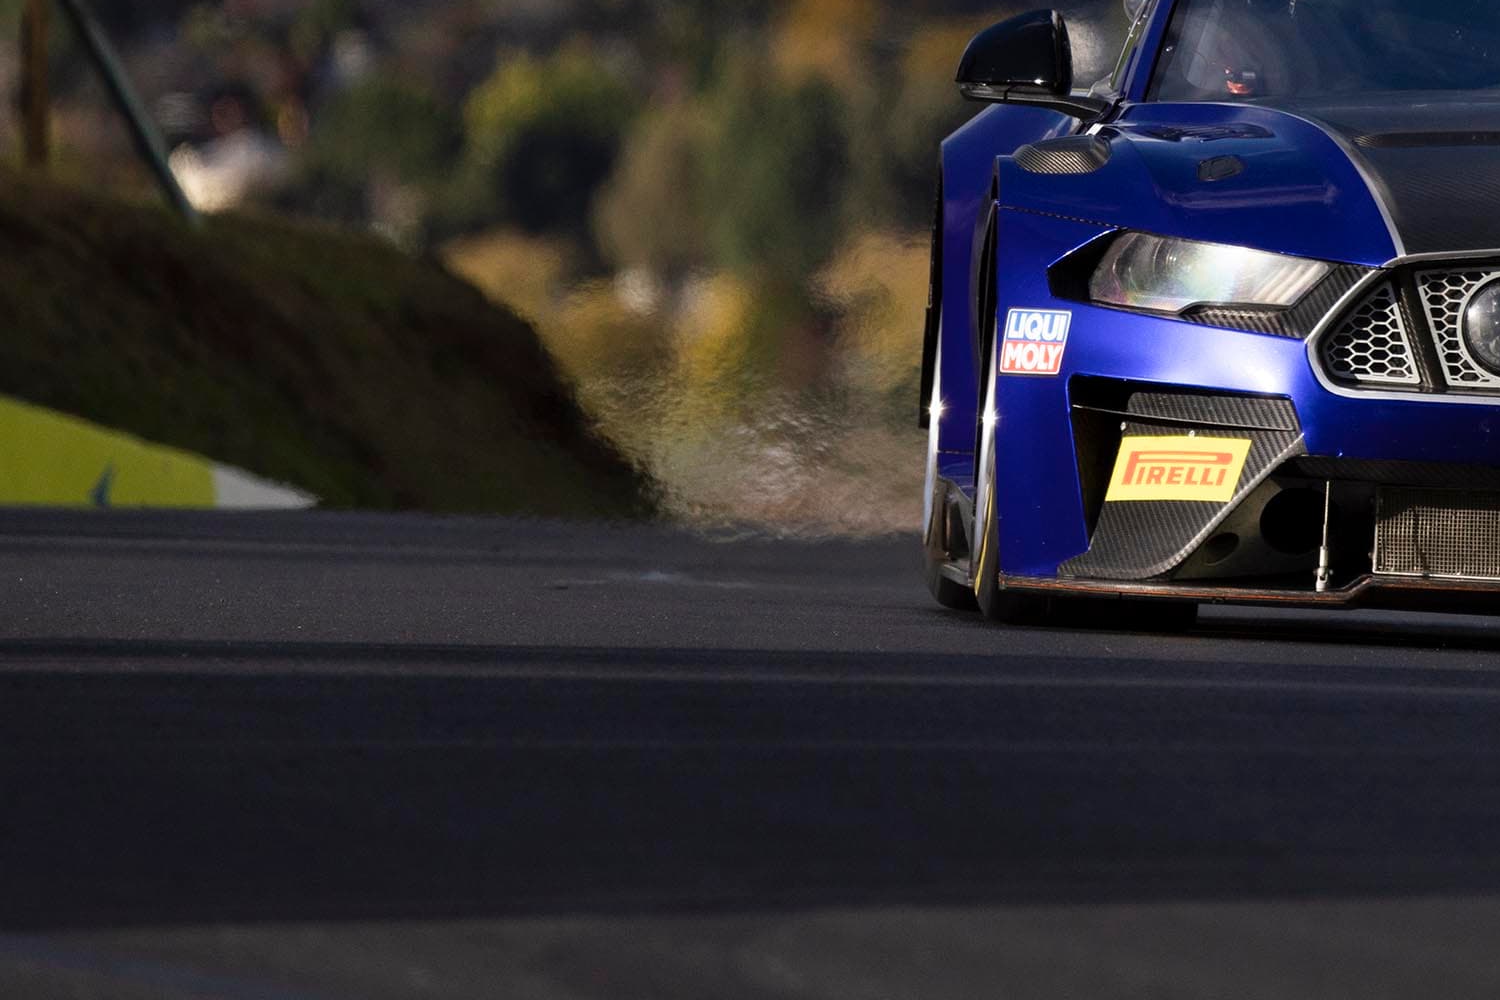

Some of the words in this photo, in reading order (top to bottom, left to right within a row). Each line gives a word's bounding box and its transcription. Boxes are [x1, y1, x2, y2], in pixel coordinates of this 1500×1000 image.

[1007, 312, 1067, 341] LIQUI
[1003, 342, 1063, 370] MOLY
[1121, 450, 1233, 486] PIRELLI
